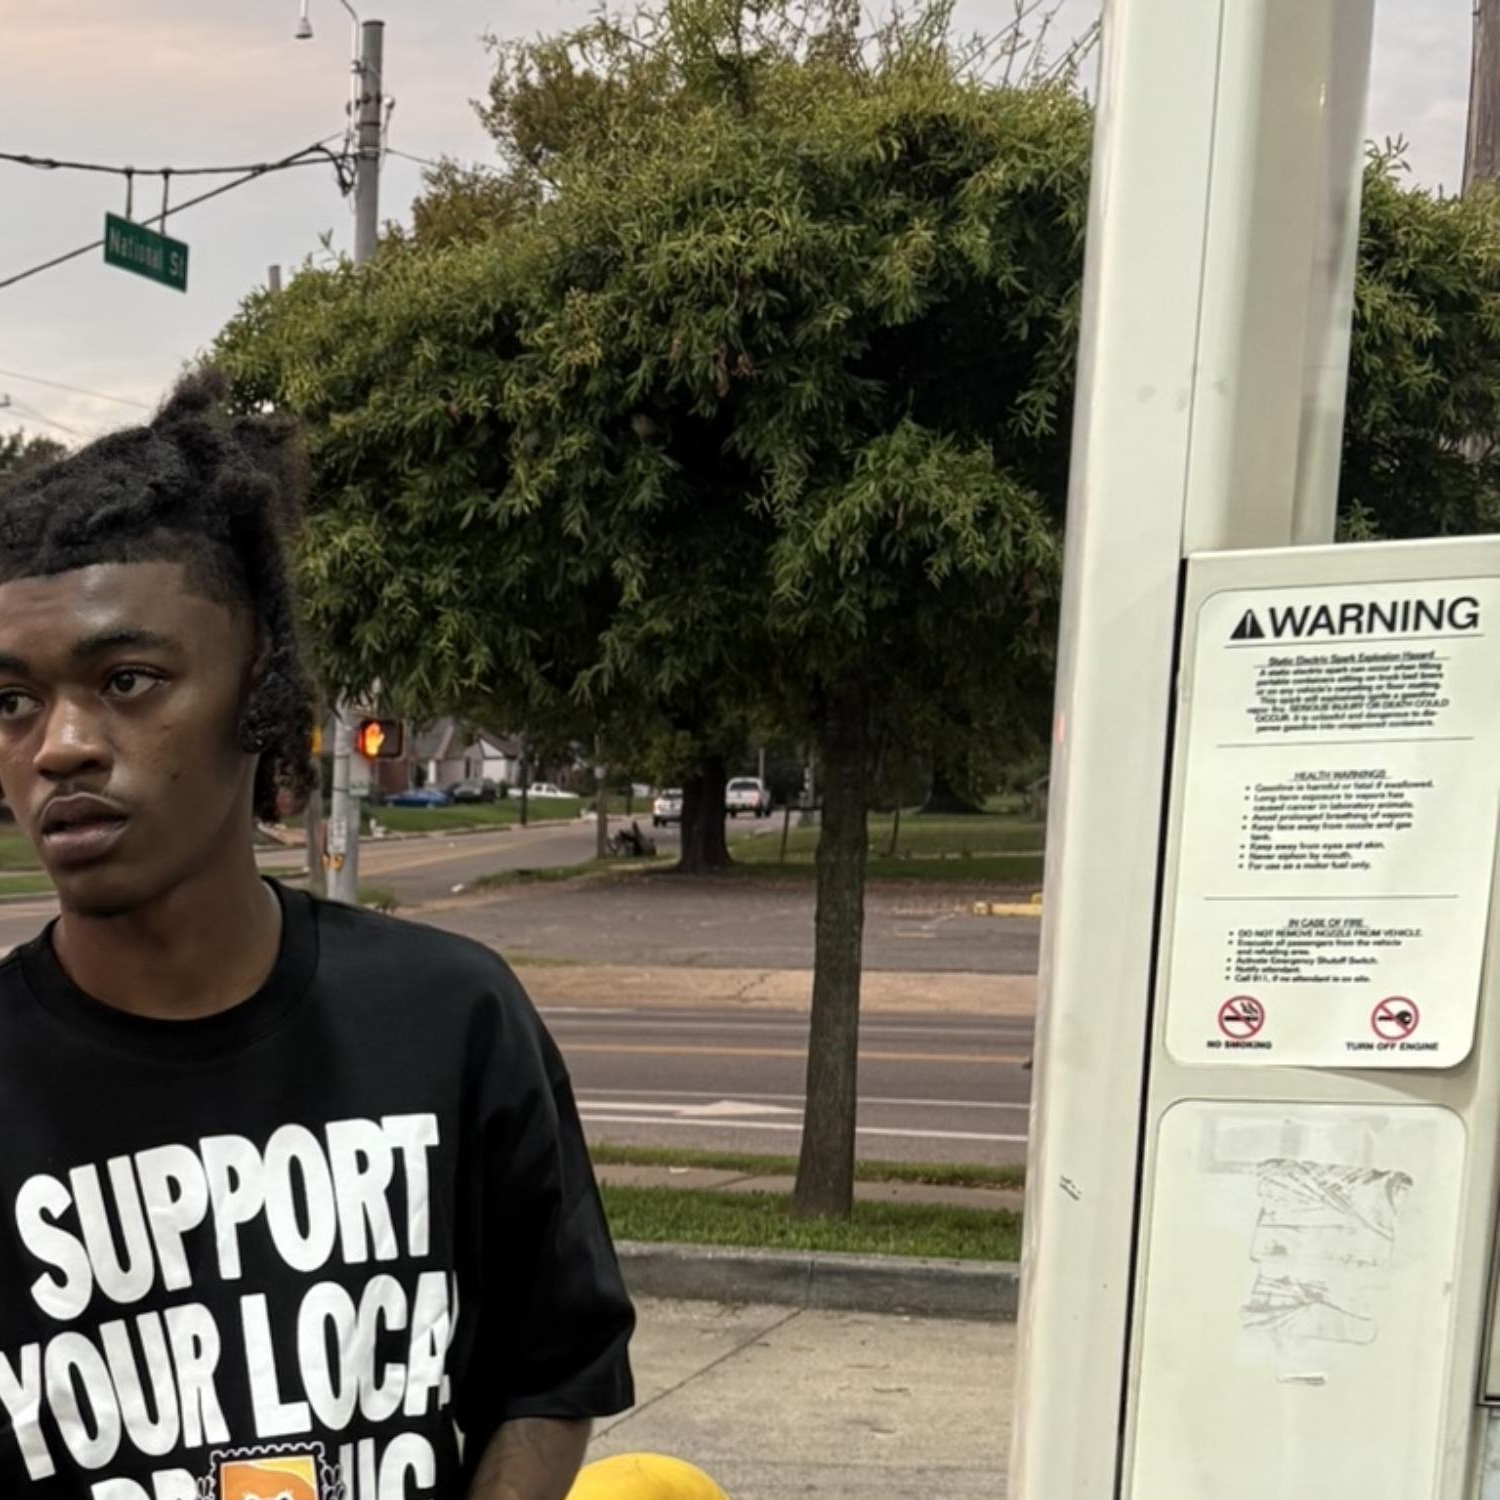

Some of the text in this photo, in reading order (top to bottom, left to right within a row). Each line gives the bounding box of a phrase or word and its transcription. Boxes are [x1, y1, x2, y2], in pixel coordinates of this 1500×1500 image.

[109, 226, 185, 279] National St
[1268, 596, 1480, 638] WARNING
[1294, 770, 1386, 780] HEALTH WARNINGS
[1225, 1041, 1272, 1049] SMOKING
[1377, 1042, 1396, 1050] OFF
[15, 1113, 439, 1321] SUPPORT
[240, 1271, 459, 1438] LOCA
